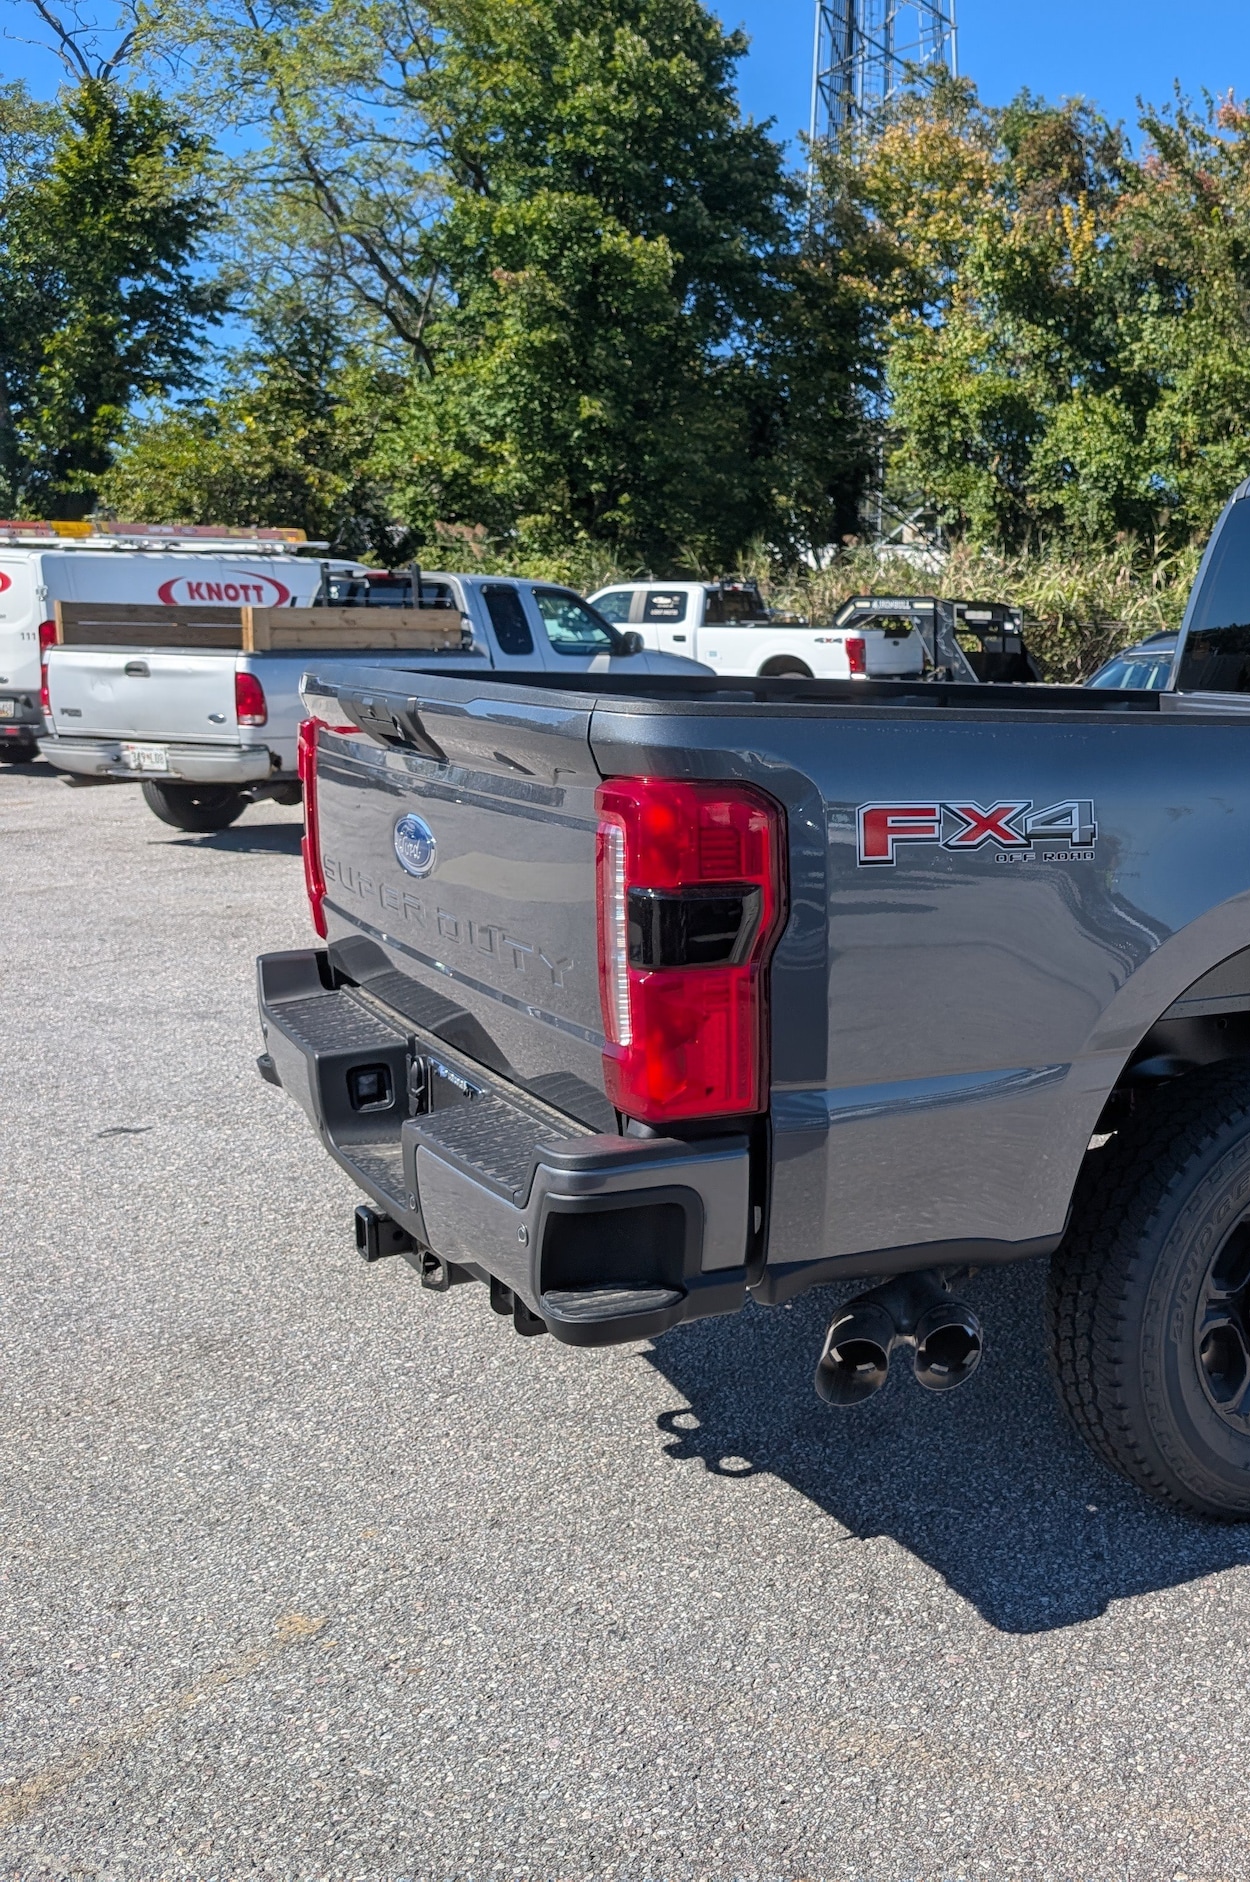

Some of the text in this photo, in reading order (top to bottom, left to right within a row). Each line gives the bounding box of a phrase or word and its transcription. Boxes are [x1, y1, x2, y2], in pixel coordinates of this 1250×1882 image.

[186, 581, 264, 603] KNOTT
[20, 632, 36, 641] 111
[856, 799, 1098, 868] FX4
[994, 851, 1096, 863] OFF ROAD
[323, 854, 576, 988] SUPER DUTY
